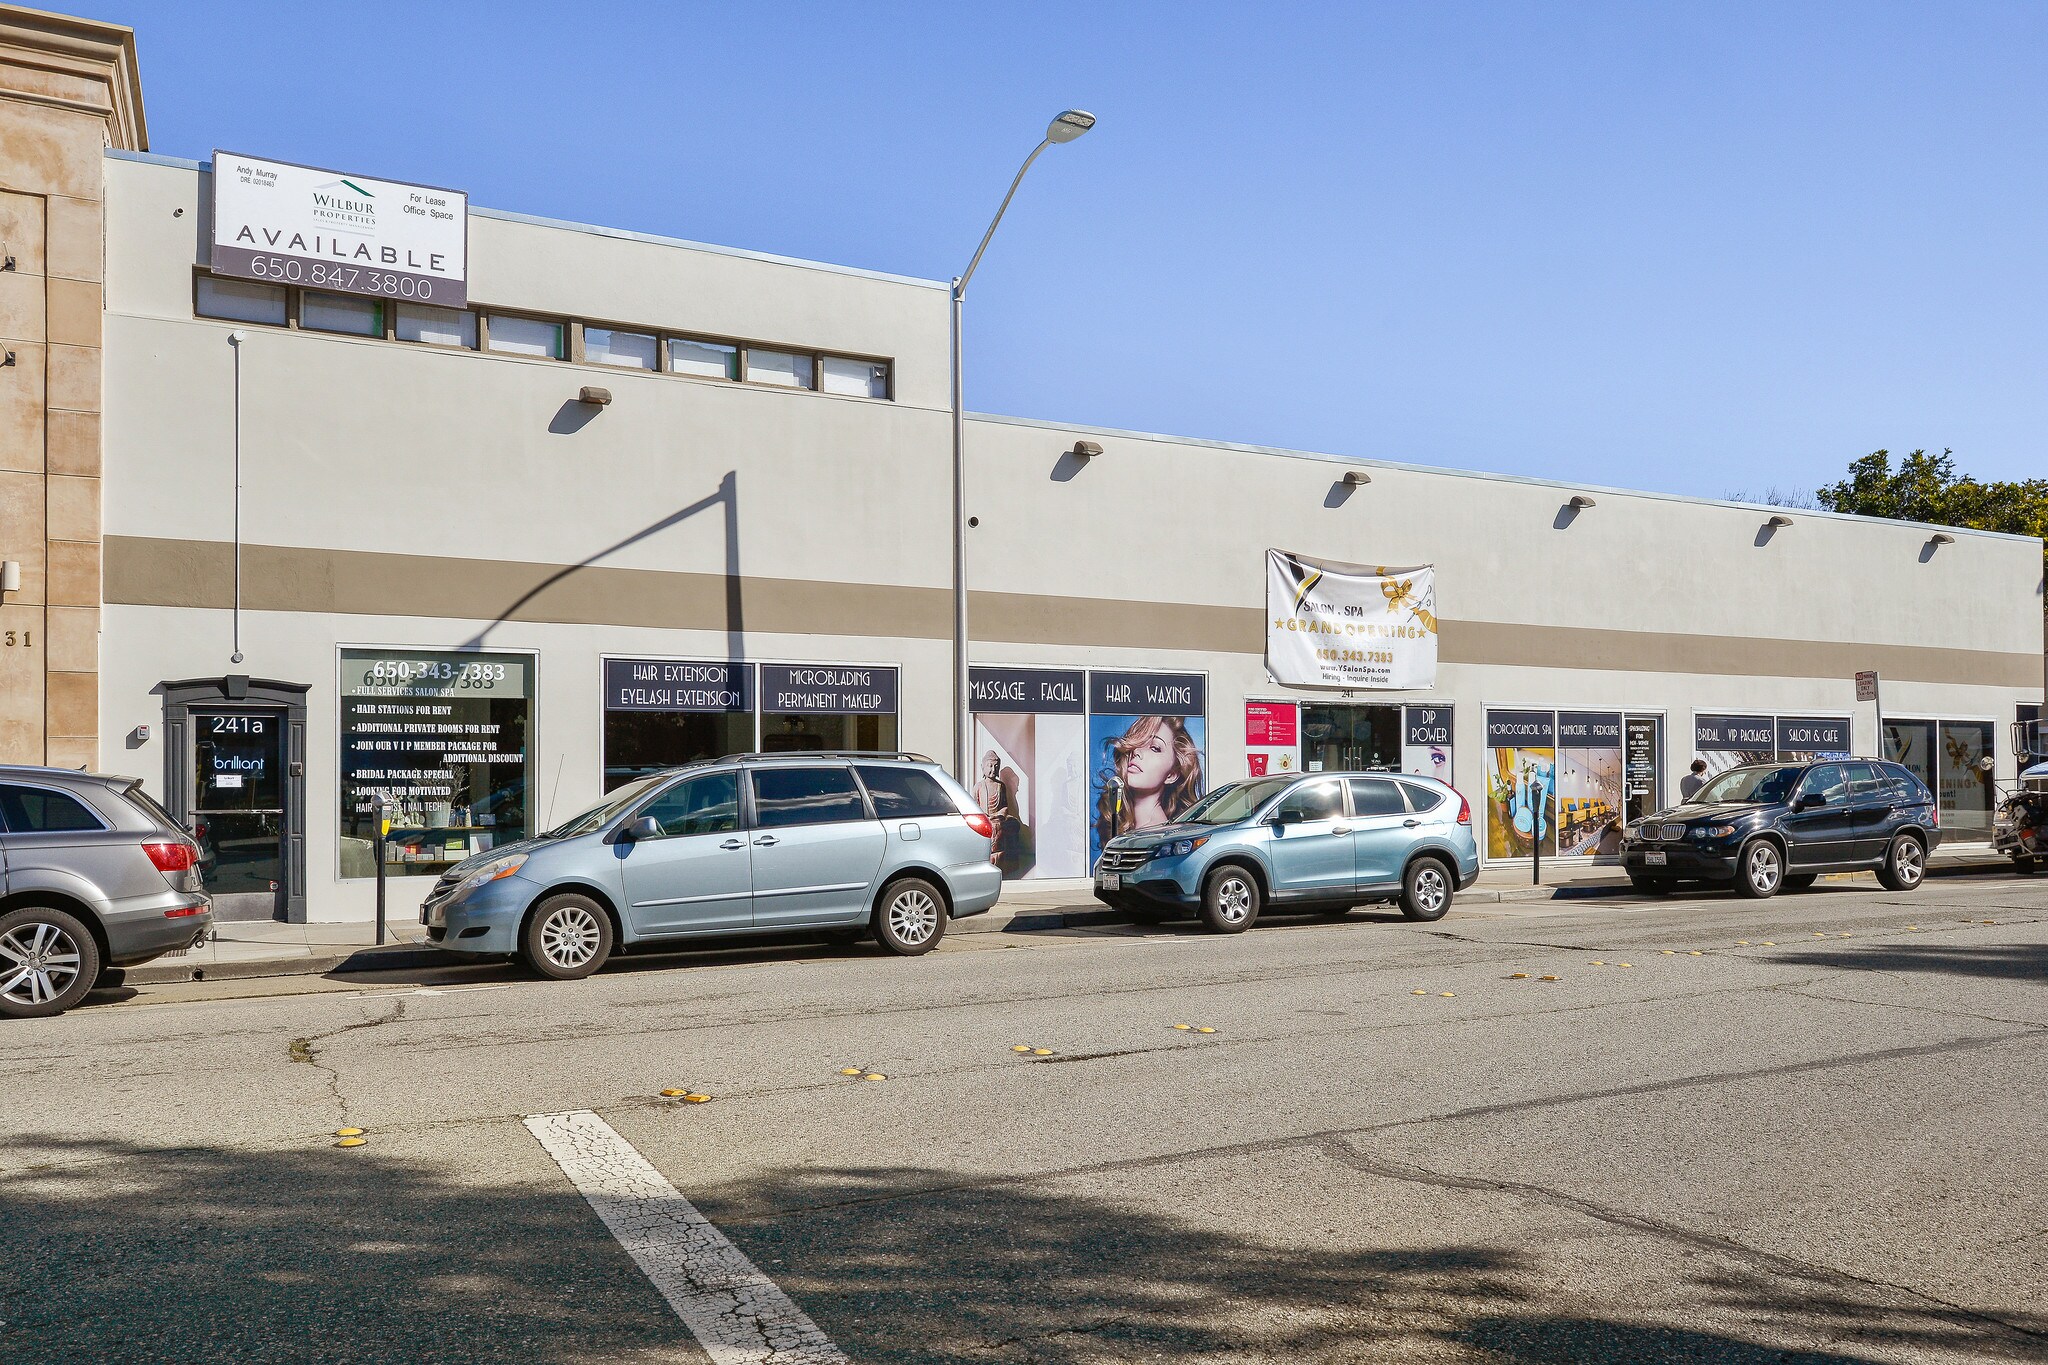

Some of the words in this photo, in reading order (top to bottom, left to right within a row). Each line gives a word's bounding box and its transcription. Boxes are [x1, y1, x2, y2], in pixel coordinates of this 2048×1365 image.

[236, 165, 252, 176] Andy
[256, 168, 278, 180] Murray
[410, 193, 422, 203] For
[425, 196, 446, 206] Lease
[313, 209, 377, 226] PROPERTIES
[403, 204, 426, 216] Office
[430, 208, 454, 221] Space
[236, 225, 446, 272] AVAILABLE
[251, 255, 433, 299] 650.847.3800
[1303, 600, 1335, 616] SALON
[1344, 605, 1364, 617] SPA
[1286, 618, 1343, 636] GRAND
[1344, 623, 1416, 639] OPENING
[1316, 648, 1393, 664] 650.343.7383
[373, 660, 506, 681] 650-343-7383
[633, 664, 659, 681] HAIR
[664, 666, 729, 683] EXTENSION
[1322, 672, 1341, 682] Hiring
[1346, 674, 1369, 683] Inquire
[1370, 675, 1389, 684] Inside
[789, 670, 871, 687] MICROBLADING
[357, 686, 376, 695] FULL
[378, 687, 413, 696] SERVICES
[415, 688, 439, 697] SALON
[440, 688, 455, 697] SPA
[620, 688, 672, 705] EYELASH
[676, 690, 741, 706] EXTENSION
[969, 680, 1026, 700] MASSAGE
[1040, 682, 1078, 702] FACIAL
[1106, 684, 1131, 703] HAIR
[1146, 686, 1192, 705] WAXING
[1341, 690, 1354, 698] 241
[778, 692, 838, 708] PERMANENT
[842, 694, 882, 710] MAKEUP
[356, 704, 376, 714] HAIR
[378, 705, 414, 715] STATIONS
[416, 705, 432, 715] FOR
[432, 706, 452, 716] RENT
[1422, 710, 1437, 724] DIP
[213, 716, 264, 734] 241a
[356, 723, 403, 733] ADDITIONAL
[404, 724, 436, 734] PRIVATE
[438, 724, 464, 734] ROOMS
[465, 724, 480, 734] FOR
[480, 724, 501, 734] RENT
[1490, 724, 1540, 735] MOROCCANOIL
[1542, 725, 1552, 735] SPA
[1560, 724, 1587, 736] MANICURE
[1593, 725, 1619, 736] PEDICURE
[1412, 727, 1448, 742] POWER
[1698, 728, 1720, 742] BRIDAL
[1728, 728, 1738, 742] VIP
[1740, 728, 1772, 742] PACKAGES
[1789, 728, 1811, 742] SALON
[1814, 729, 1820, 742] &
[1822, 730, 1838, 743] CAFE
[355, 741, 374, 750] JOIN
[376, 741, 392, 750] OUR
[393, 741, 400, 750] V
[400, 742, 404, 750] I
[406, 742, 412, 750] P
[413, 741, 446, 751] MEMBER
[448, 742, 482, 751] PACKAGE
[482, 742, 498, 751] FOR
[213, 755, 265, 770] brilliant
[442, 754, 487, 763] ADDITIONAL
[488, 754, 524, 764] DISCOUNT
[356, 770, 386, 779] BRIDAL
[387, 770, 422, 780] PACKAGE
[423, 770, 454, 780] SPECIAL
[392, 786, 407, 796] FOR
[408, 786, 451, 796] MOTIVATED
[356, 802, 373, 812] HAIR
[408, 802, 424, 812] NAIL
[424, 802, 443, 812] TECH
